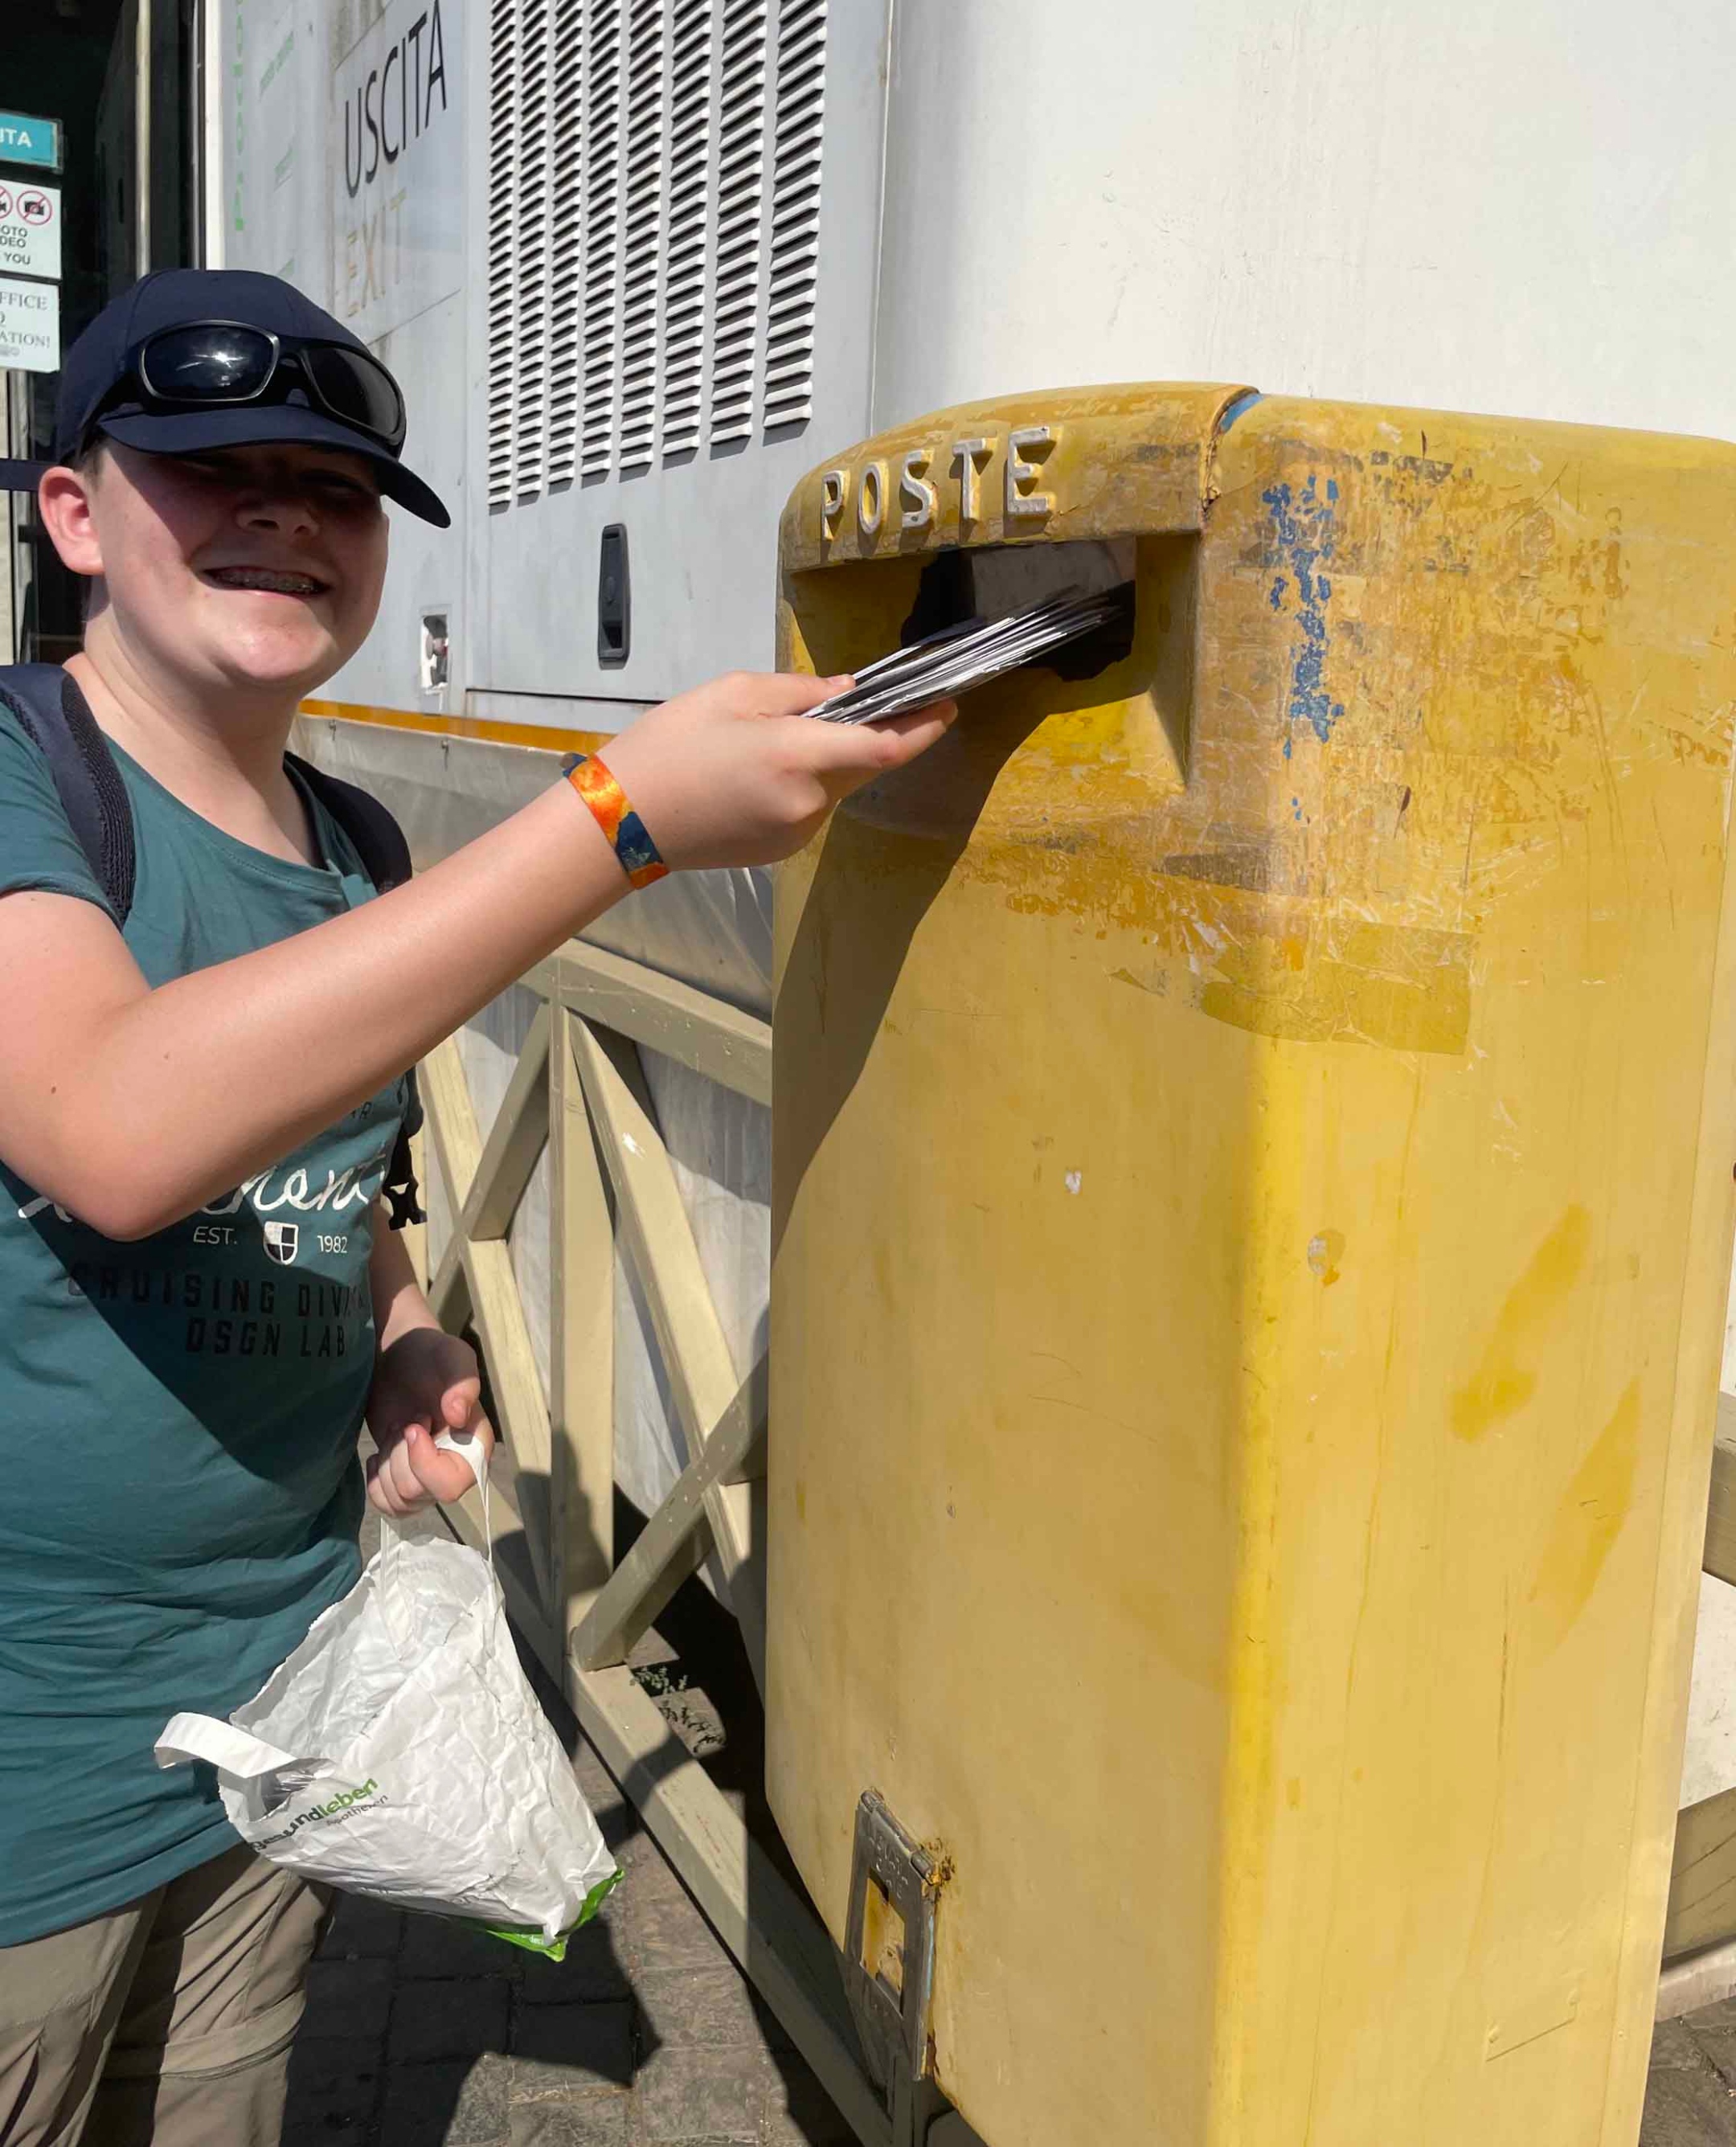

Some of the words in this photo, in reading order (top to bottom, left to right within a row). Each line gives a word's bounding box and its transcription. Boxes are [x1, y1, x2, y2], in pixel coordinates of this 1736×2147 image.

[345, 0, 447, 198] USCITA
[4, 252, 31, 265] YOU
[345, 186, 407, 318] EXIT
[821, 427, 1056, 541] POSTE
[193, 1225, 238, 1245] EST.
[317, 1235, 348, 1254] 1982
[186, 1317, 281, 1358] DSGN
[299, 1324, 348, 1358] LAB
